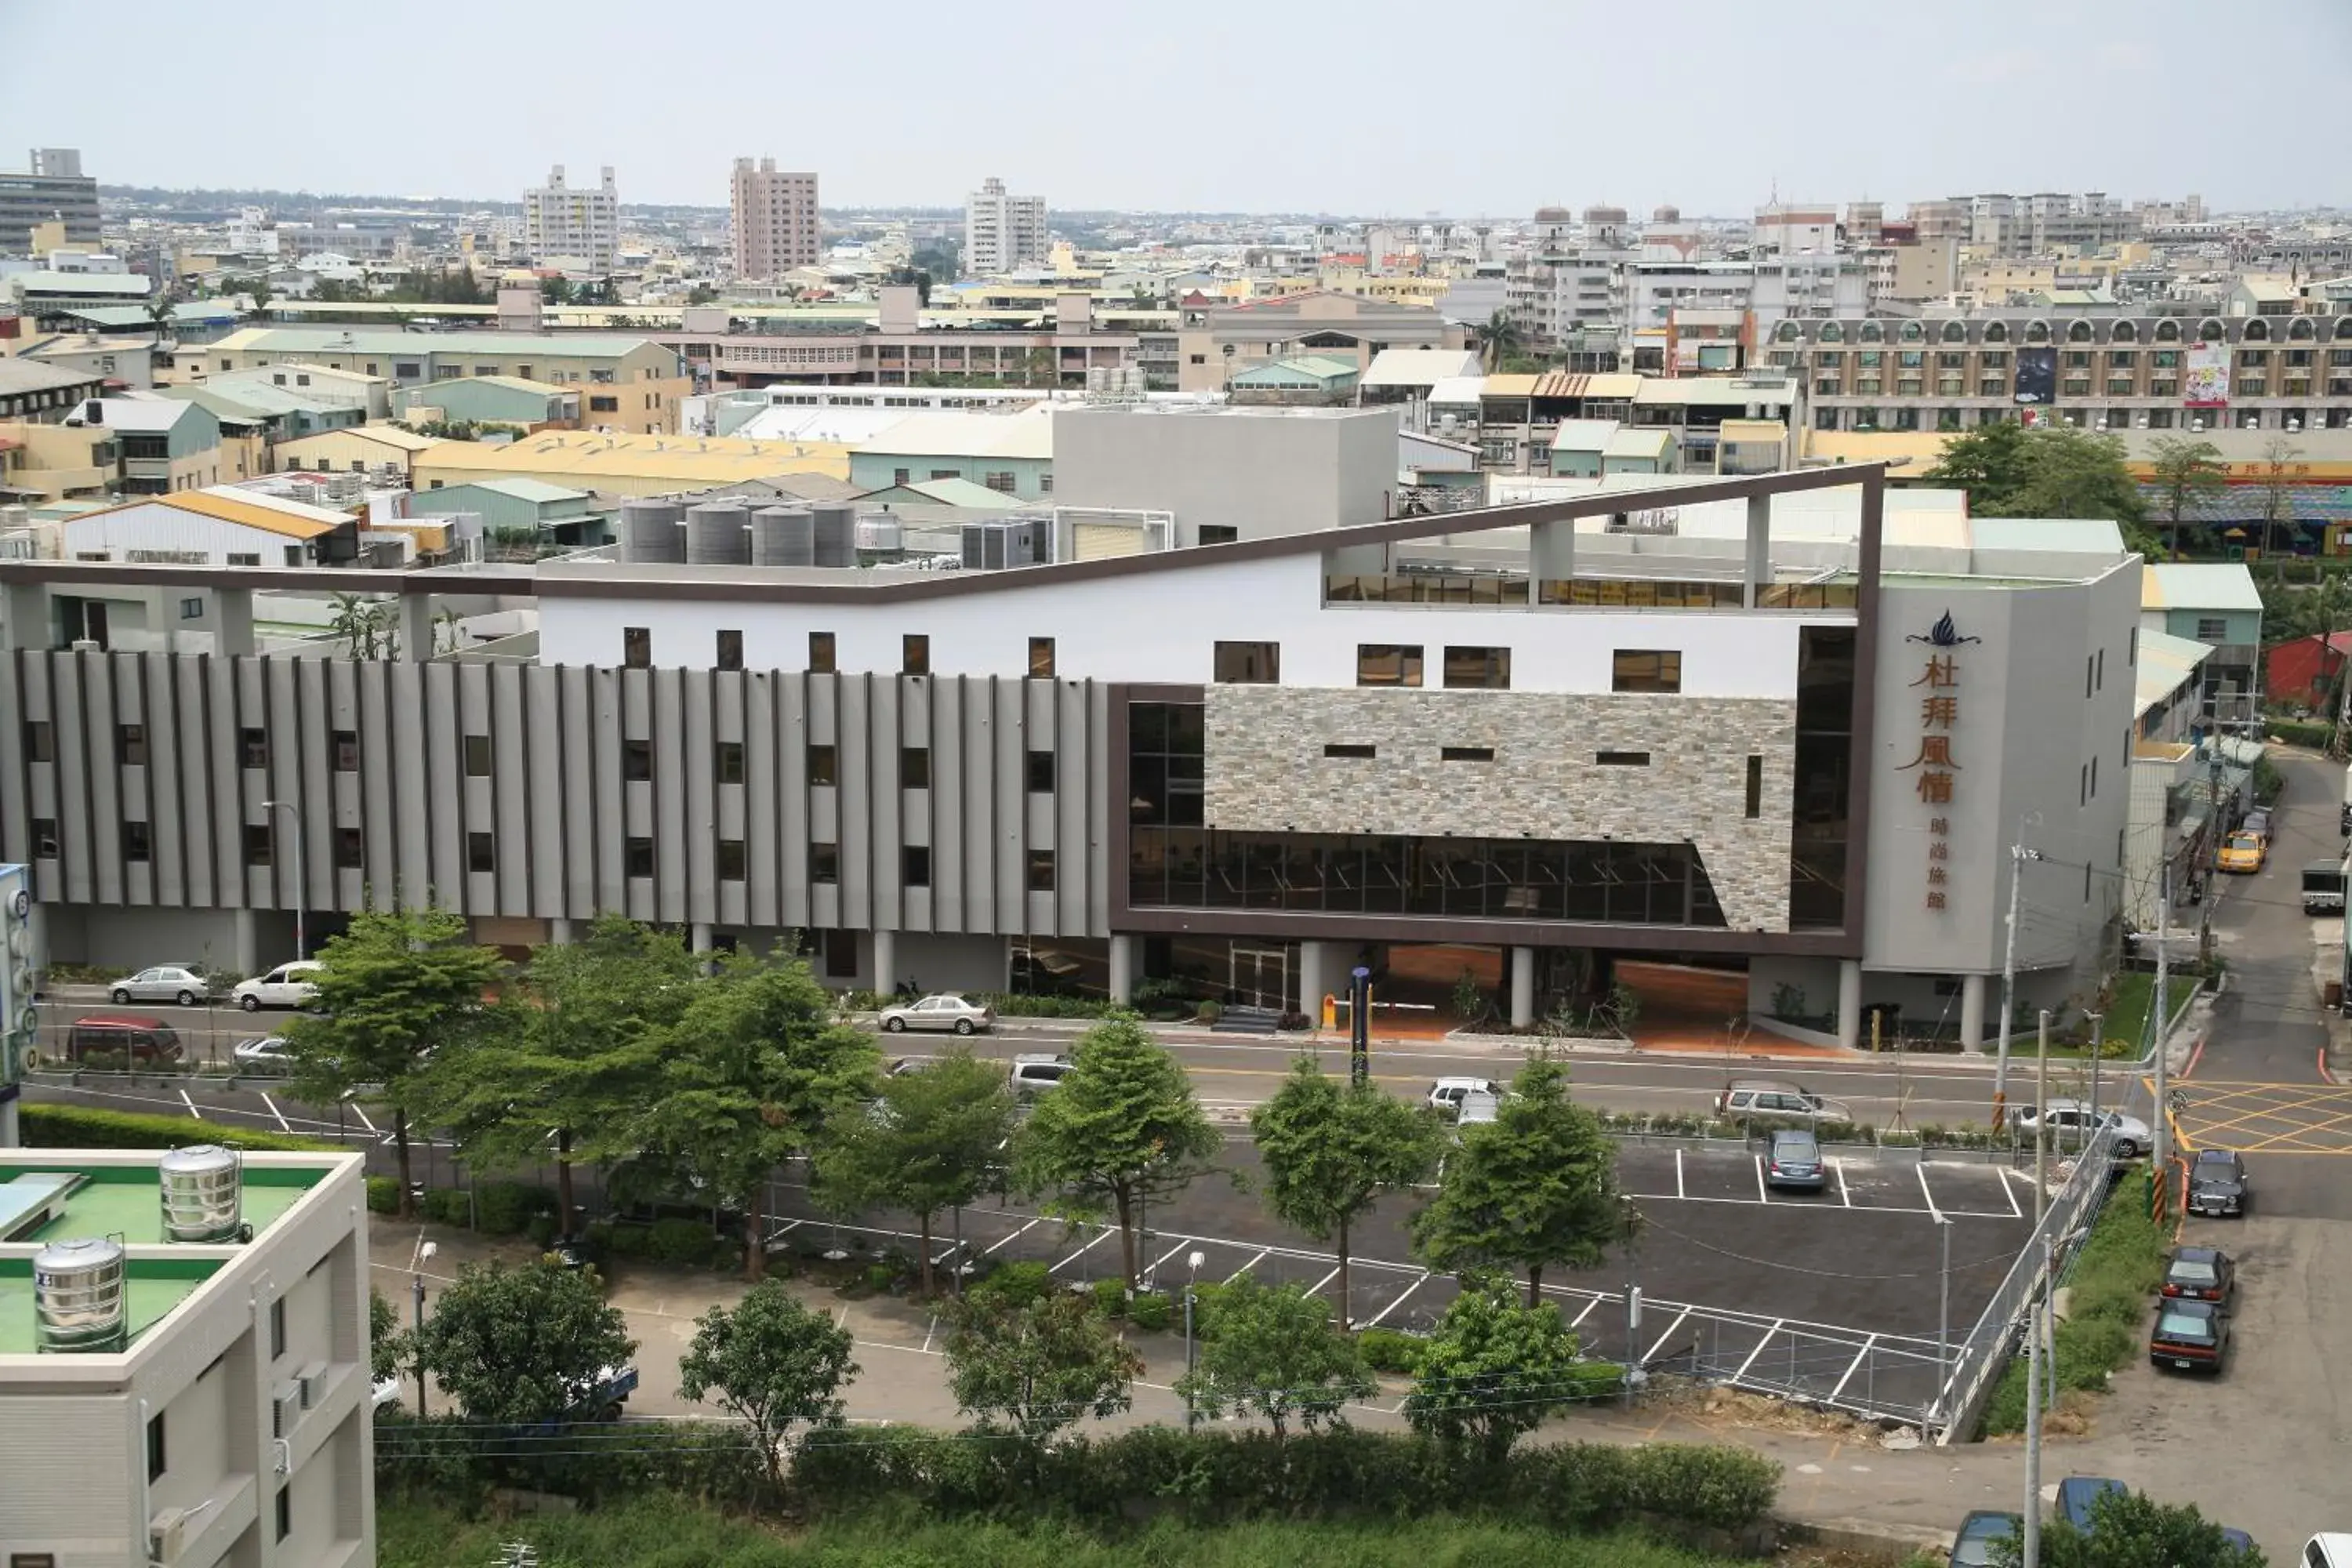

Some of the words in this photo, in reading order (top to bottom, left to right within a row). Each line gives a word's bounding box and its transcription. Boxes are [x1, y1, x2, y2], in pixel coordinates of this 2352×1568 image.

[1894, 654, 1962, 804] 杜拜風情
[1927, 817, 1949, 909] 時尚旅館
